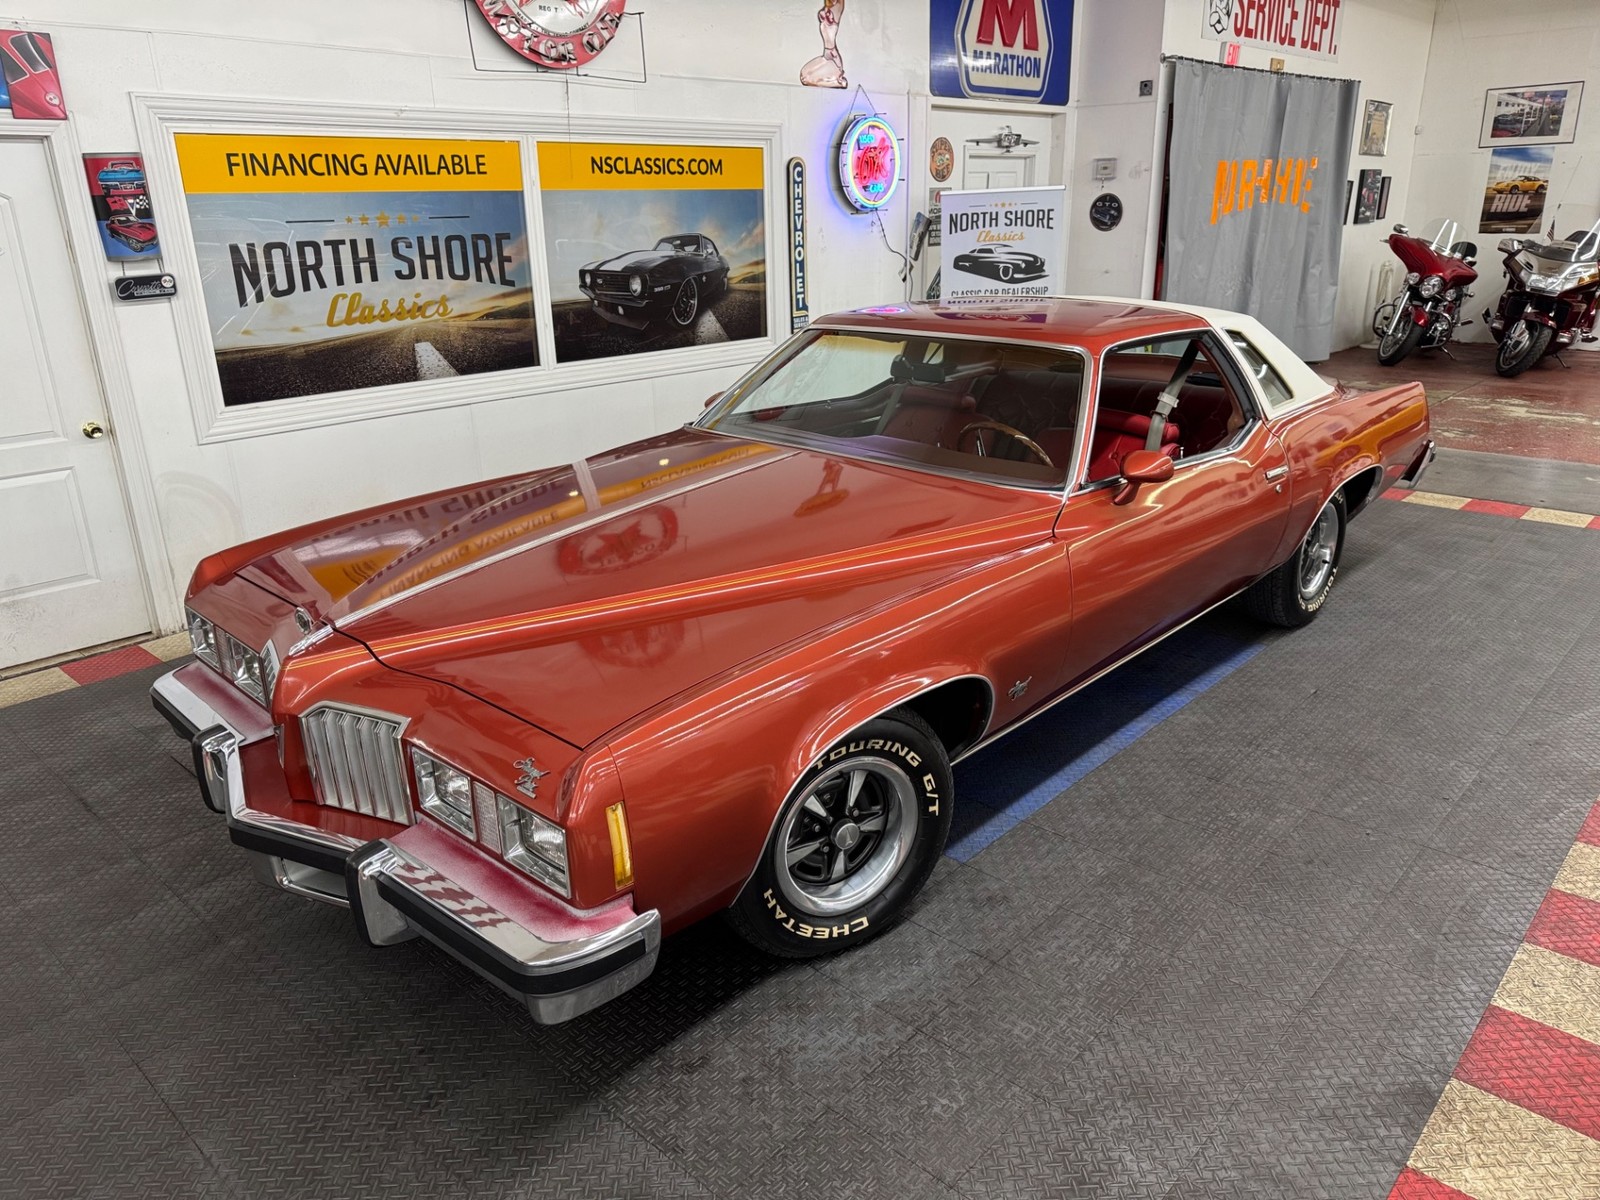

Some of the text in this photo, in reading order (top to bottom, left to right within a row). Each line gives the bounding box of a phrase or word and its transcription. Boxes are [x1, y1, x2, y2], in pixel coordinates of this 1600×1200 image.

[1233, 0, 1340, 56] SERVICE DEPT.
[971, 50, 1041, 79] MARATHON
[225, 153, 488, 177] FINANCING AVAILABLE
[590, 156, 723, 176] NSCLASSICS.COM
[1490, 193, 1531, 213] RIDE
[949, 211, 999, 235] NORTH
[1004, 208, 1055, 230] SHORE
[793, 167, 805, 308] CHEVROLET
[976, 230, 1026, 243] Classics
[228, 232, 517, 308] NORTH SHORE
[1001, 286, 1049, 296] DEALERSHIP
[326, 292, 453, 328] Classics
[811, 739, 939, 816] TOURING G/T
[764, 887, 869, 939] CHEETAH
